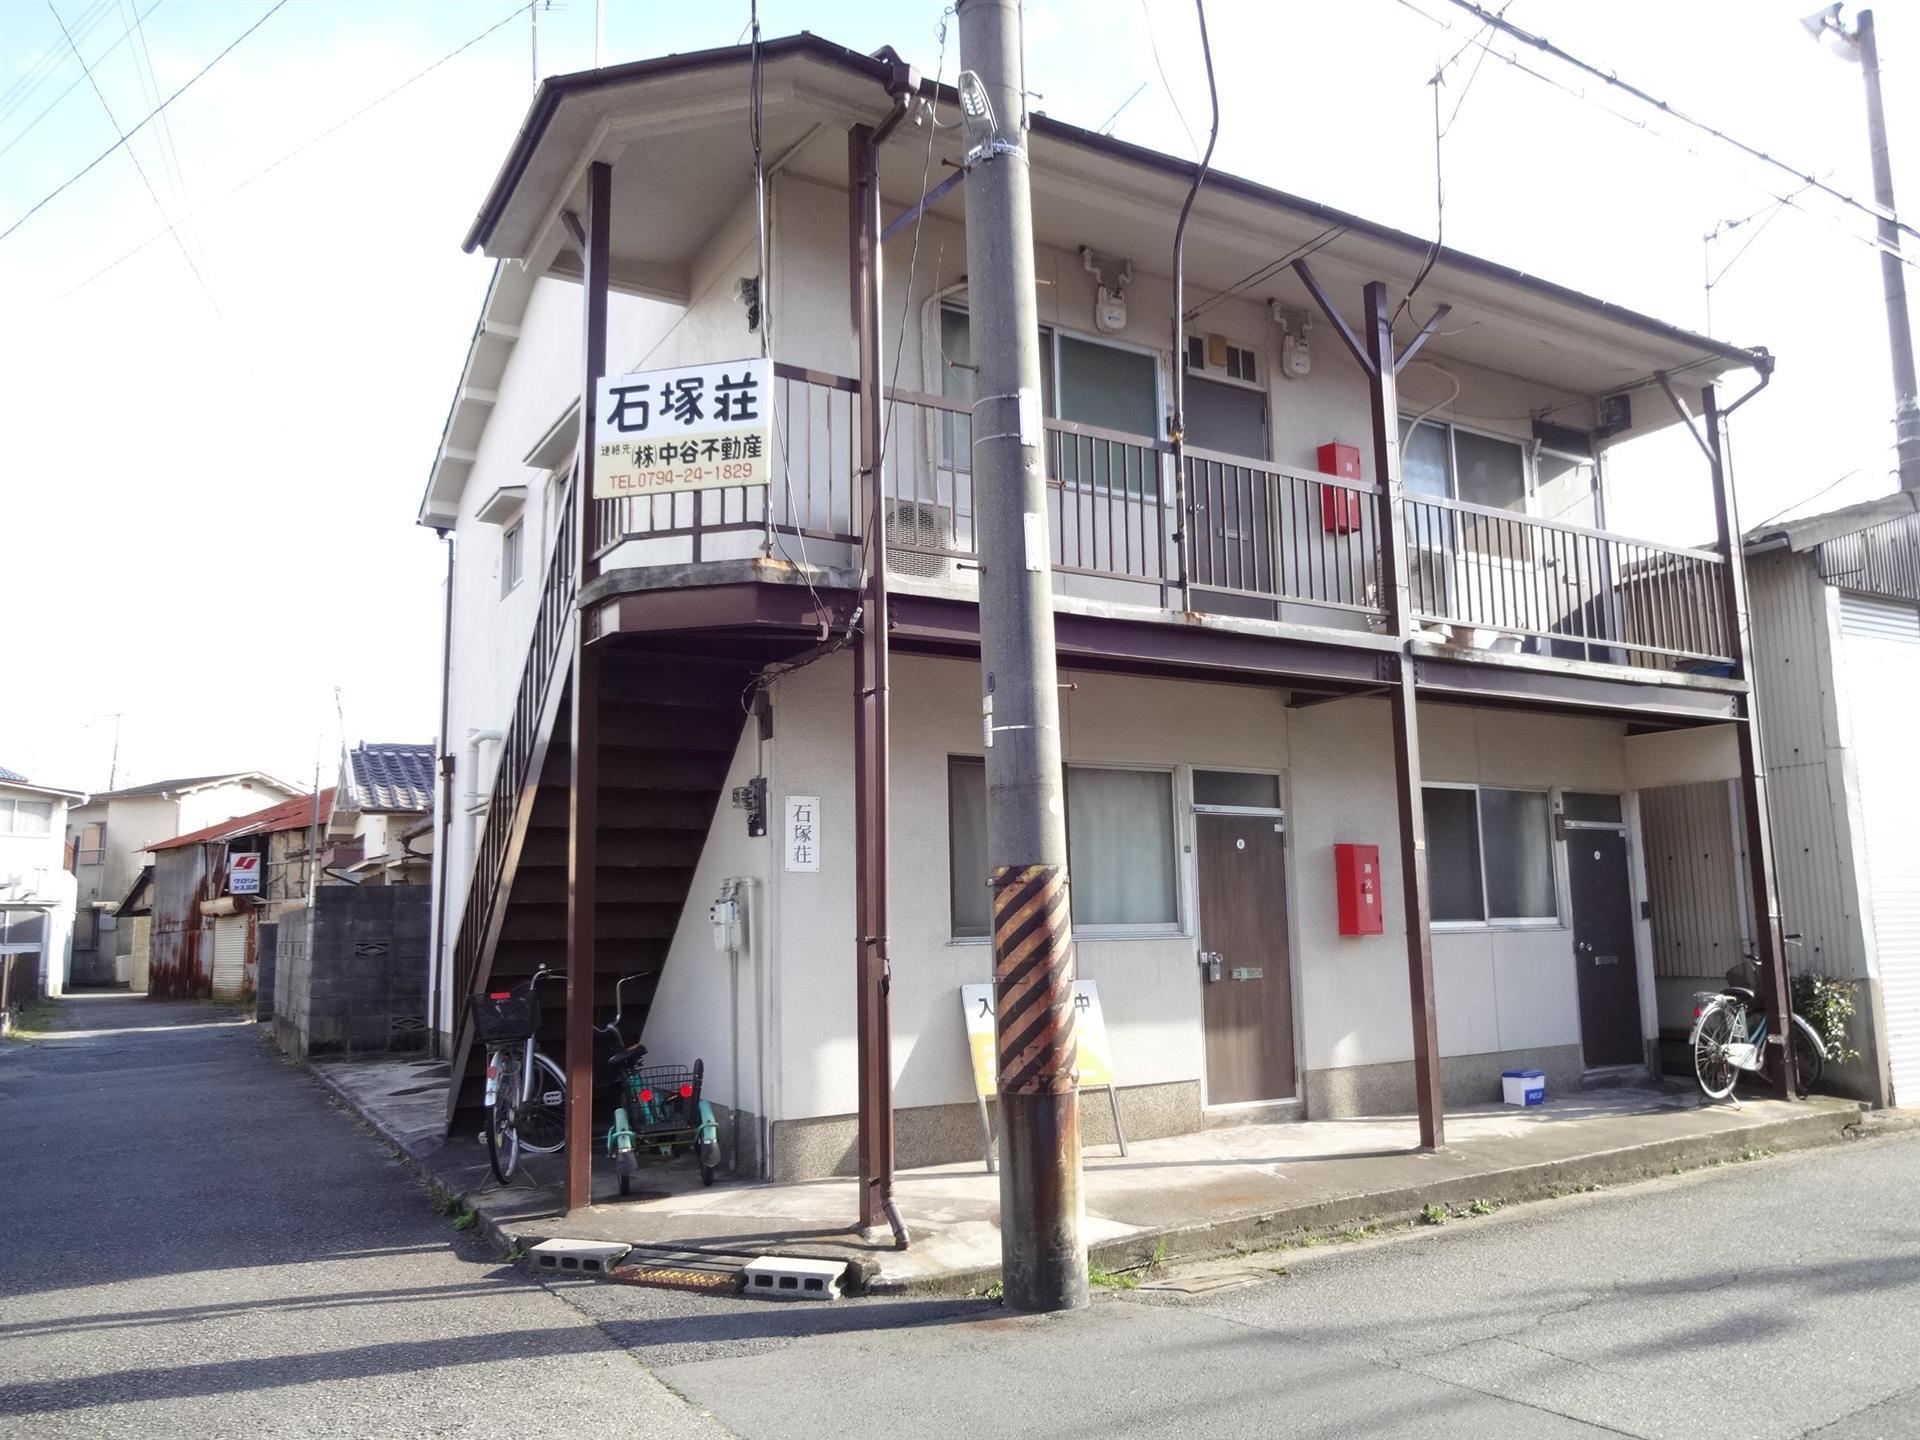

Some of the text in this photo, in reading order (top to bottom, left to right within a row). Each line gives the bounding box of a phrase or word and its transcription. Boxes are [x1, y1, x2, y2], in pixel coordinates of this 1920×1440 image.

[606, 371, 759, 433] 石塚荘
[792, 803, 812, 864] 石塚荘
